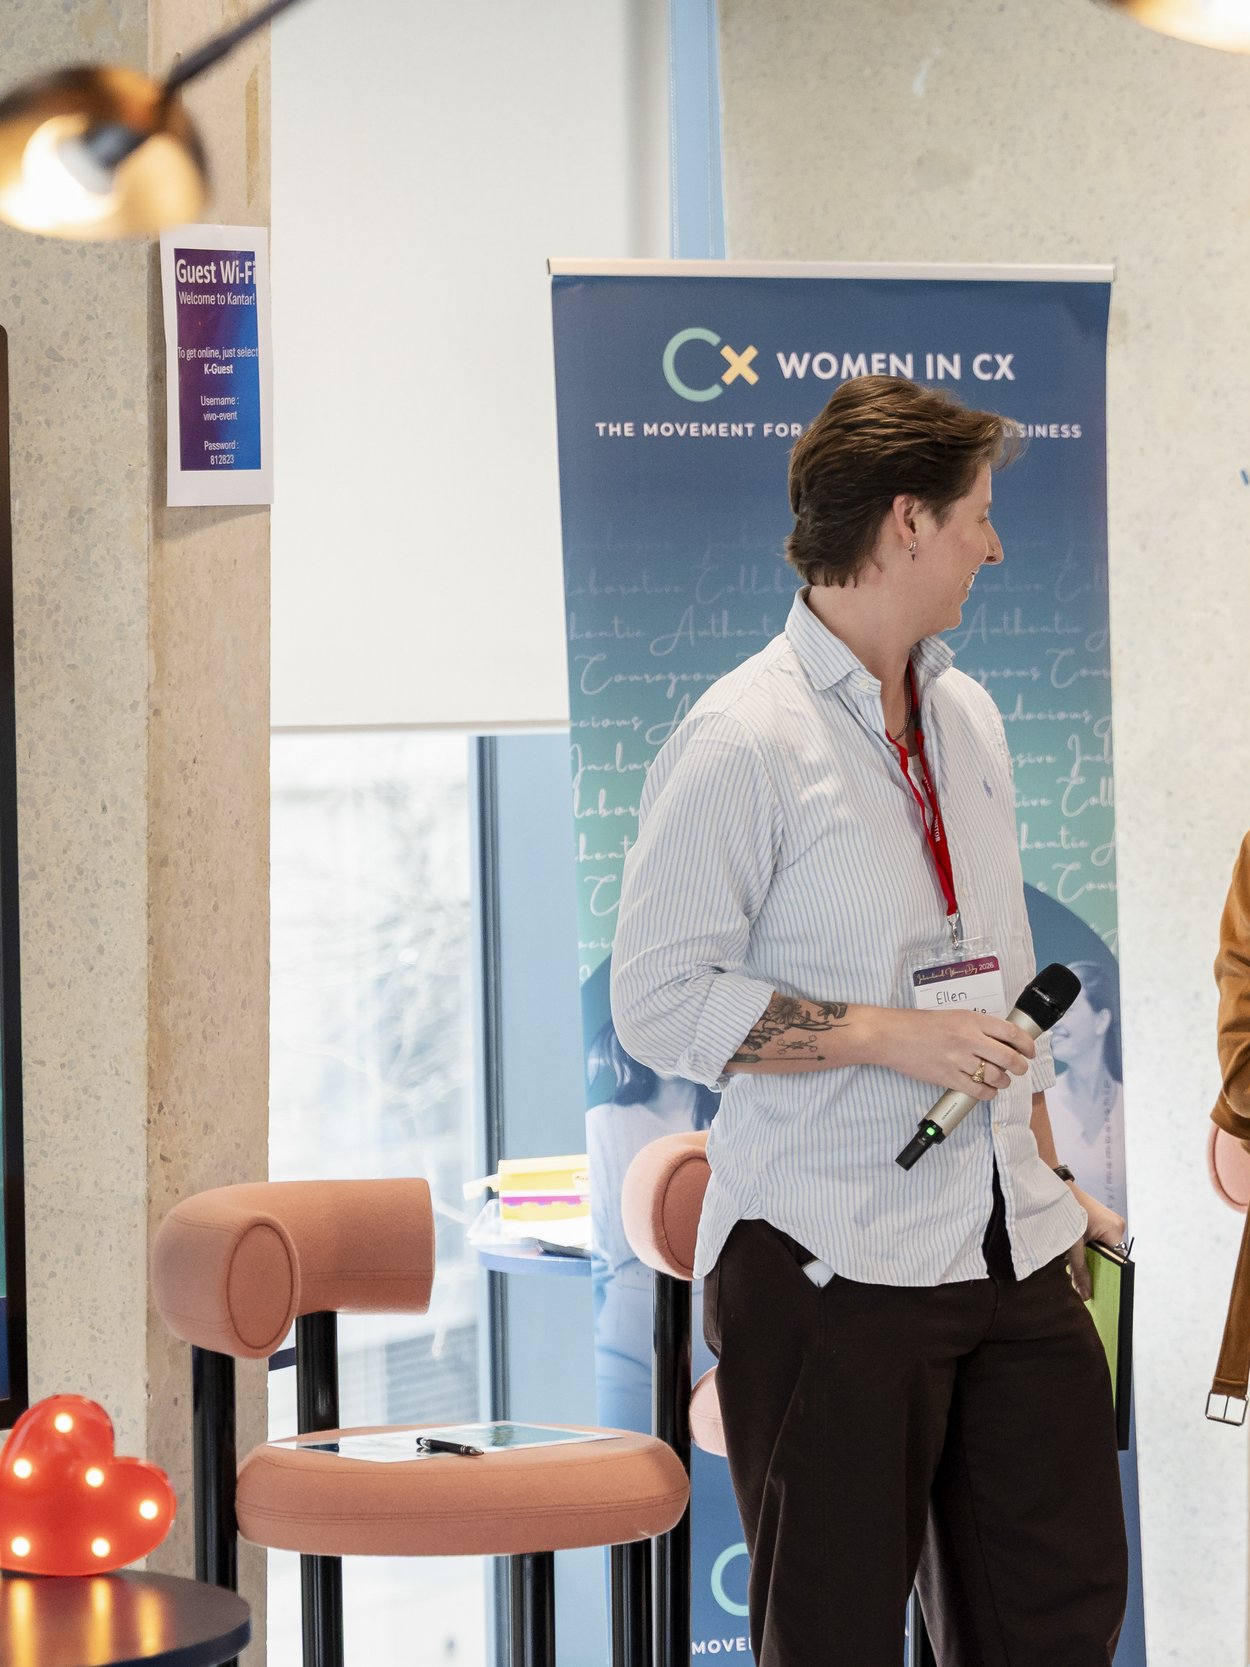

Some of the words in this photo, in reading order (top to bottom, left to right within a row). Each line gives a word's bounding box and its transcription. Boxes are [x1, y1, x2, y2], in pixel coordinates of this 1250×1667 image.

[176, 259, 217, 284] Guest
[219, 260, 256, 285] Wi-Fi
[178, 291, 216, 305] Welcome
[216, 293, 226, 305] to
[227, 292, 256, 305] Kantar!
[177, 346, 186, 359] To
[185, 347, 198, 361] get
[197, 346, 222, 360] online,
[222, 346, 237, 361] just
[236, 346, 259, 358] select
[203, 363, 234, 375] K-Guest
[776, 352, 914, 380] WOMEN
[926, 353, 962, 381] IN
[972, 353, 1016, 381] CX
[200, 395, 236, 406] Username
[203, 410, 238, 421] vivo-event
[595, 422, 636, 437] THE
[642, 422, 755, 438] MOVEMENT
[762, 423, 802, 438] FOR
[1002, 423, 1083, 439] USINESS
[204, 440, 236, 451] Password
[210, 454, 235, 465] 812823
[978, 961, 995, 971] 2026
[936, 990, 968, 1005] Ellen
